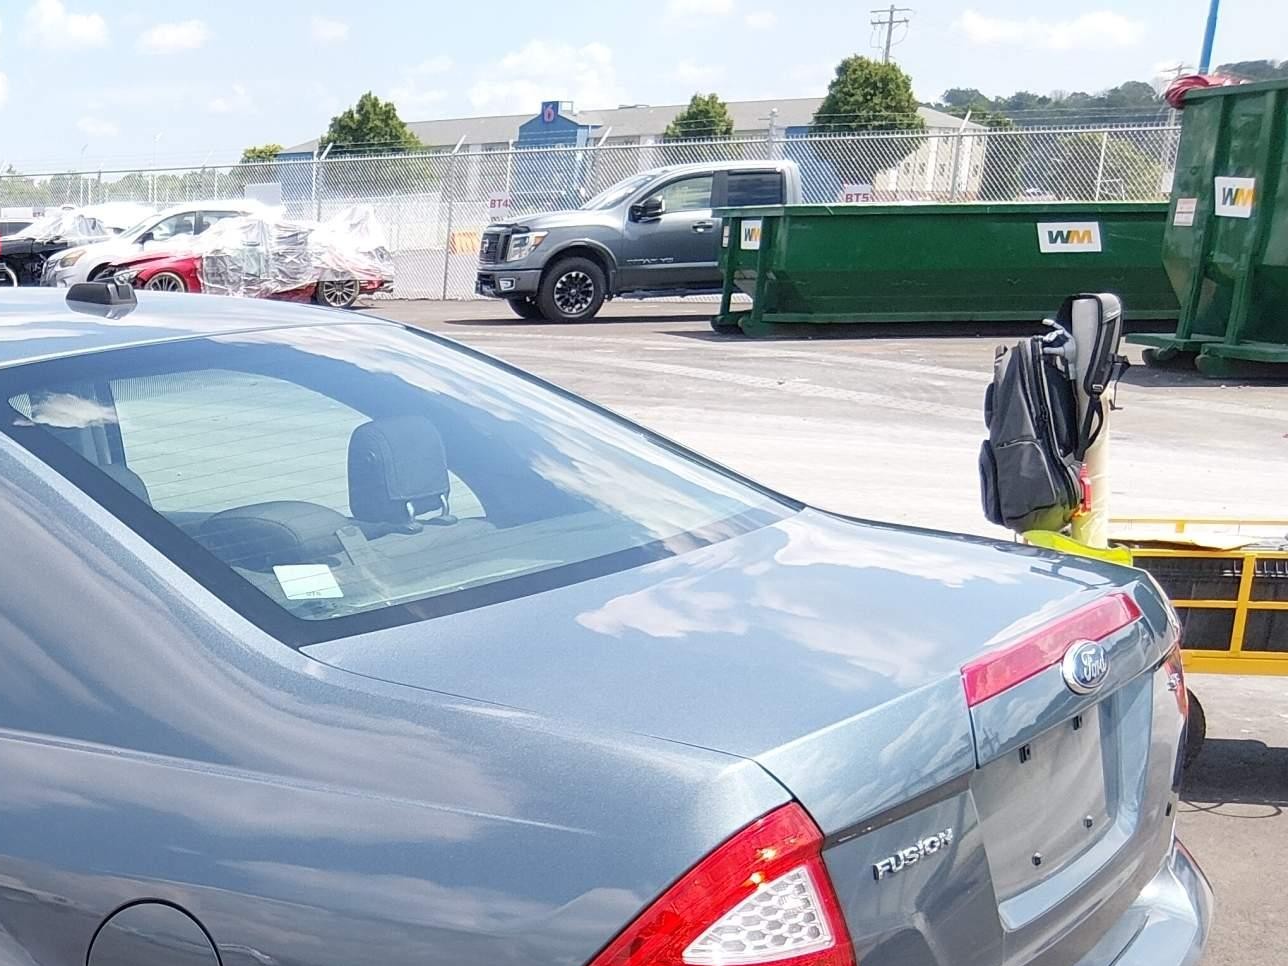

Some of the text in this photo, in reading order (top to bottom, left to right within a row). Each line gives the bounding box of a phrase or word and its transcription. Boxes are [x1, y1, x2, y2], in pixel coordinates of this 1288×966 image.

[544, 104, 555, 122] 6
[1222, 187, 1257, 207] WM
[1047, 230, 1094, 244] WM
[1081, 648, 1107, 681] Ford
[873, 827, 953, 881] FUSION
